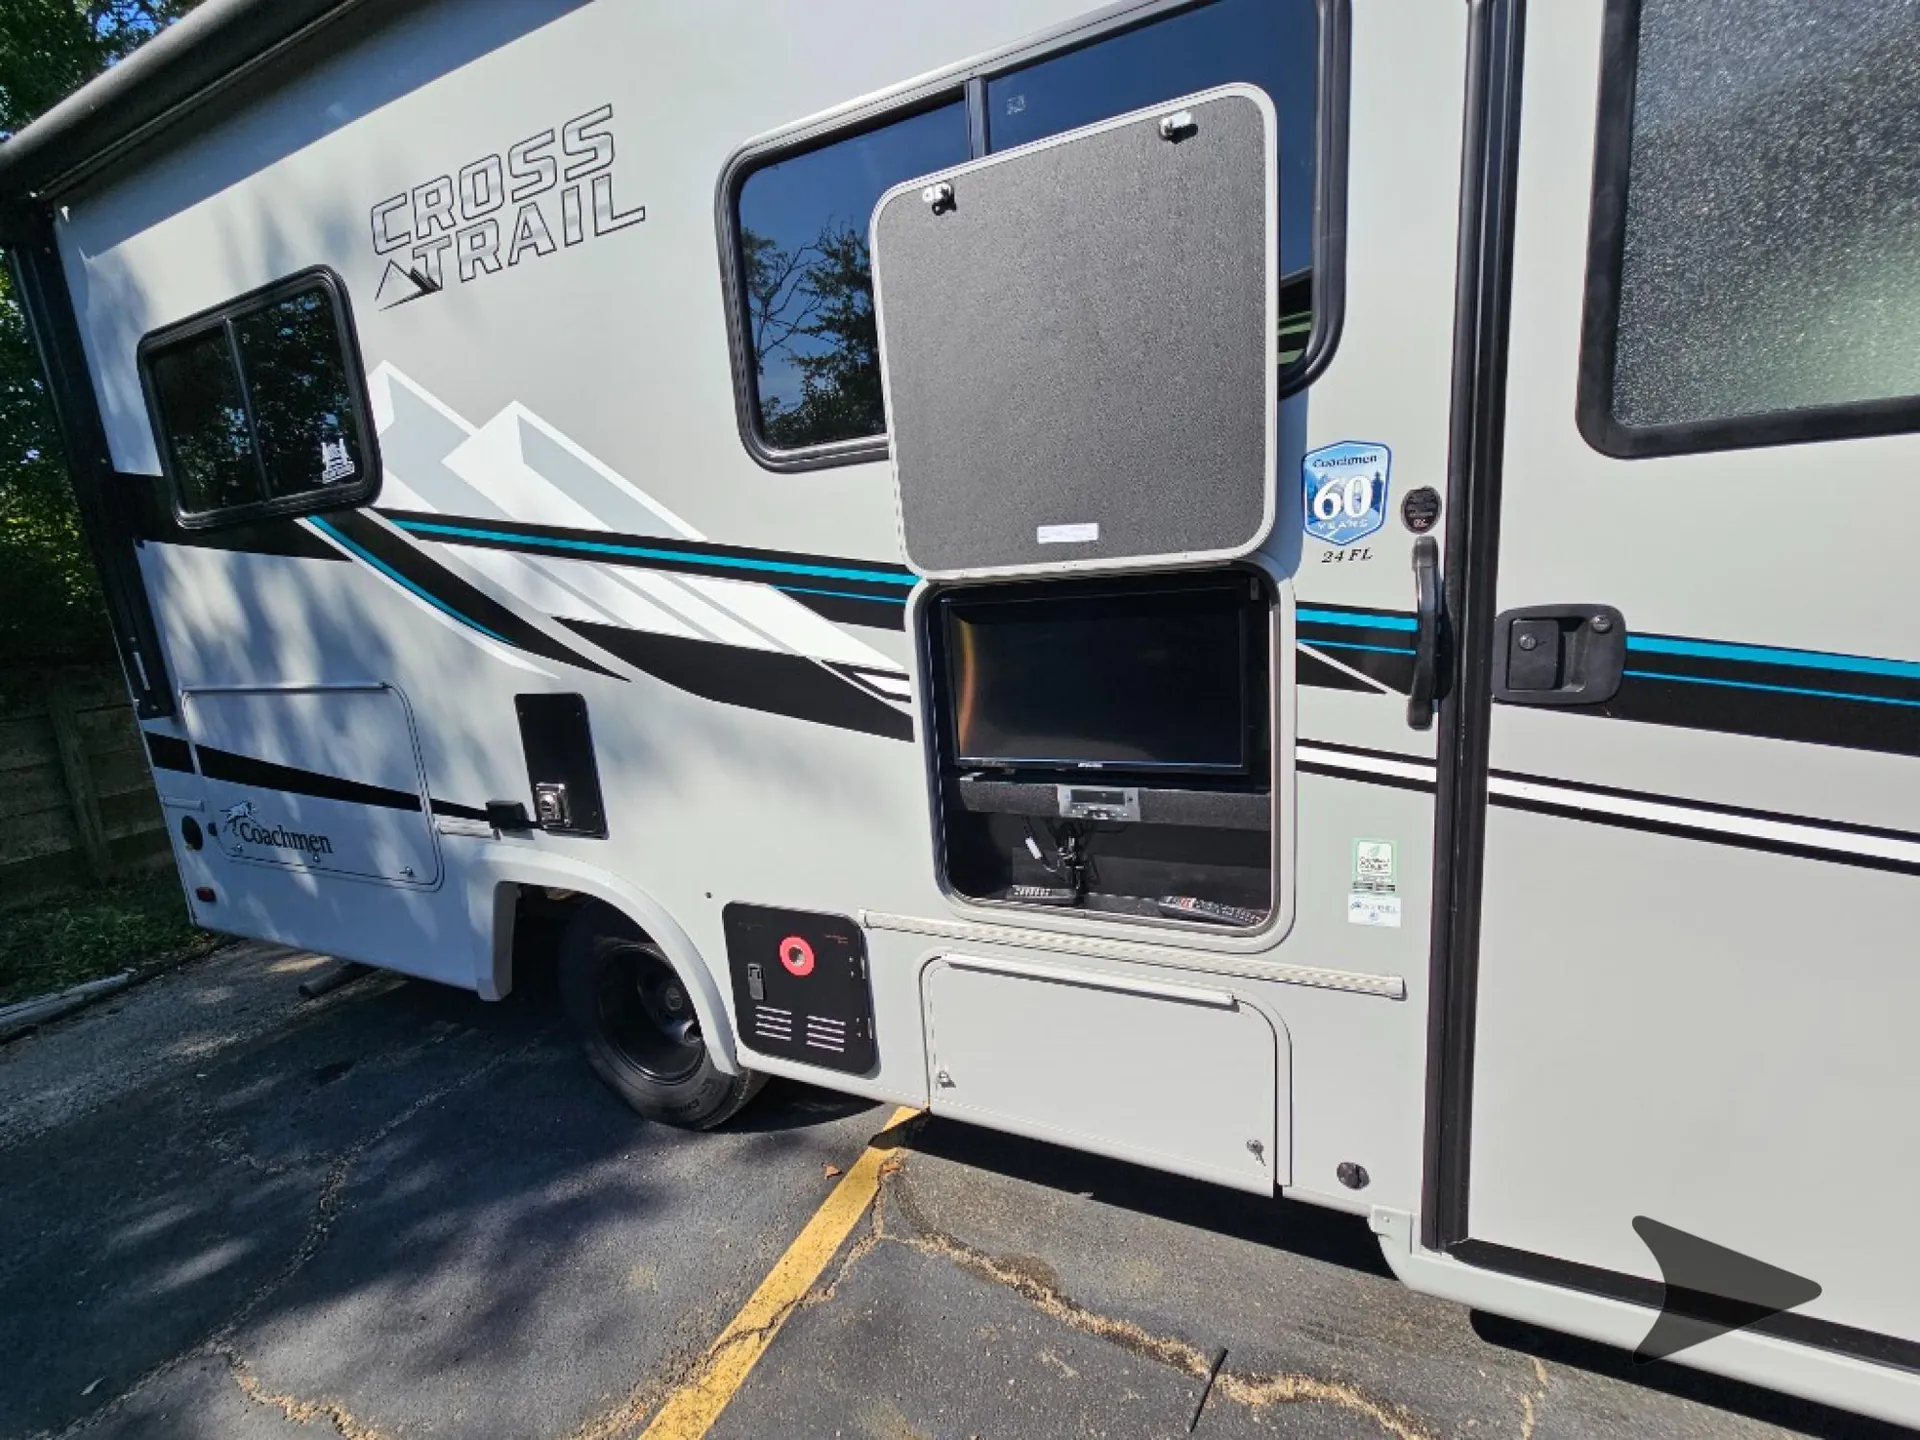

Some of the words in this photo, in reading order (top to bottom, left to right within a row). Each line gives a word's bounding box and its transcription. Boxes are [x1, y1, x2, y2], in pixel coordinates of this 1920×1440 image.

[371, 103, 615, 255] CROSS
[412, 172, 645, 291] TRAIL
[1313, 475, 1373, 520] 60
[1321, 550, 1345, 563] 24
[1348, 547, 1373, 561] FL
[239, 822, 334, 853] Coachmen
